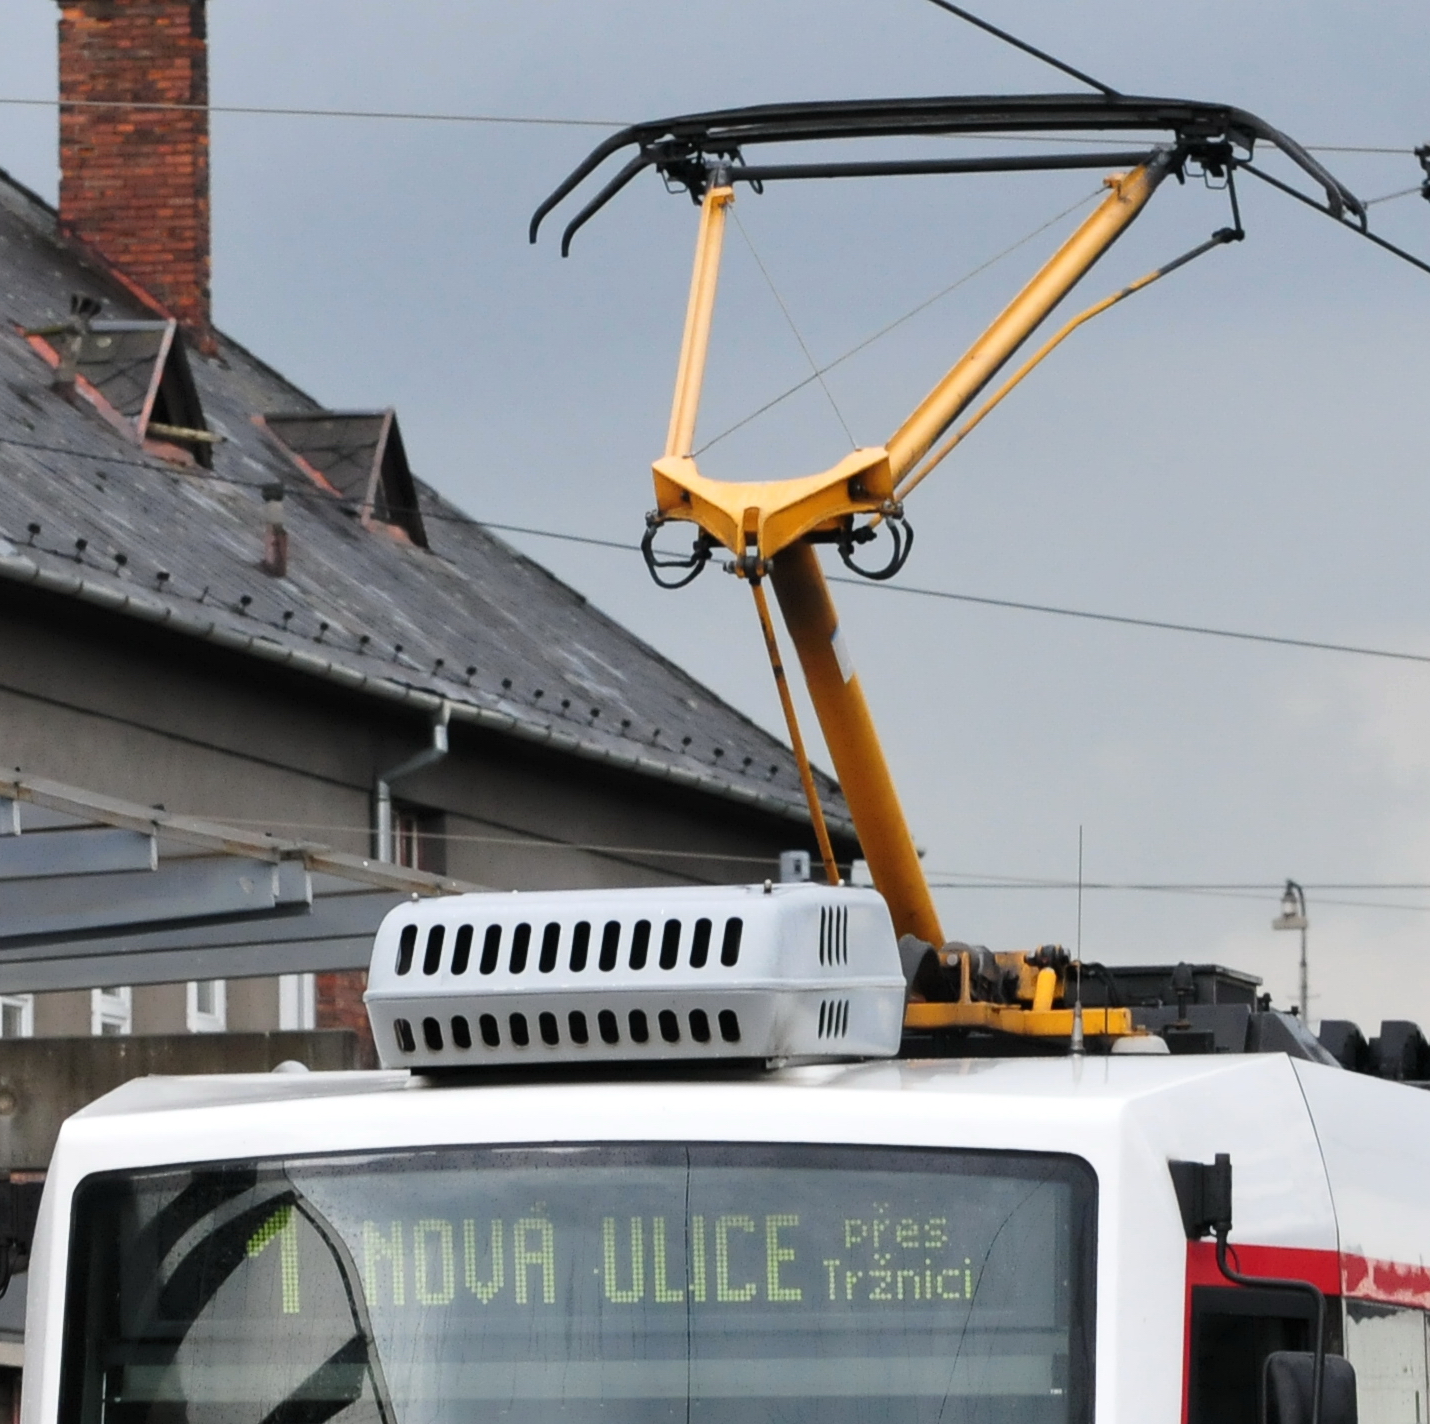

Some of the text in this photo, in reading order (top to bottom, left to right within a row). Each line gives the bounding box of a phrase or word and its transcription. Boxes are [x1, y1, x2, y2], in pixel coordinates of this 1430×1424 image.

[845, 1202, 948, 1248] přes
[247, 1201, 802, 1313] 1 NOVÁ ULICE
[823, 1253, 971, 1300] Tržnici
